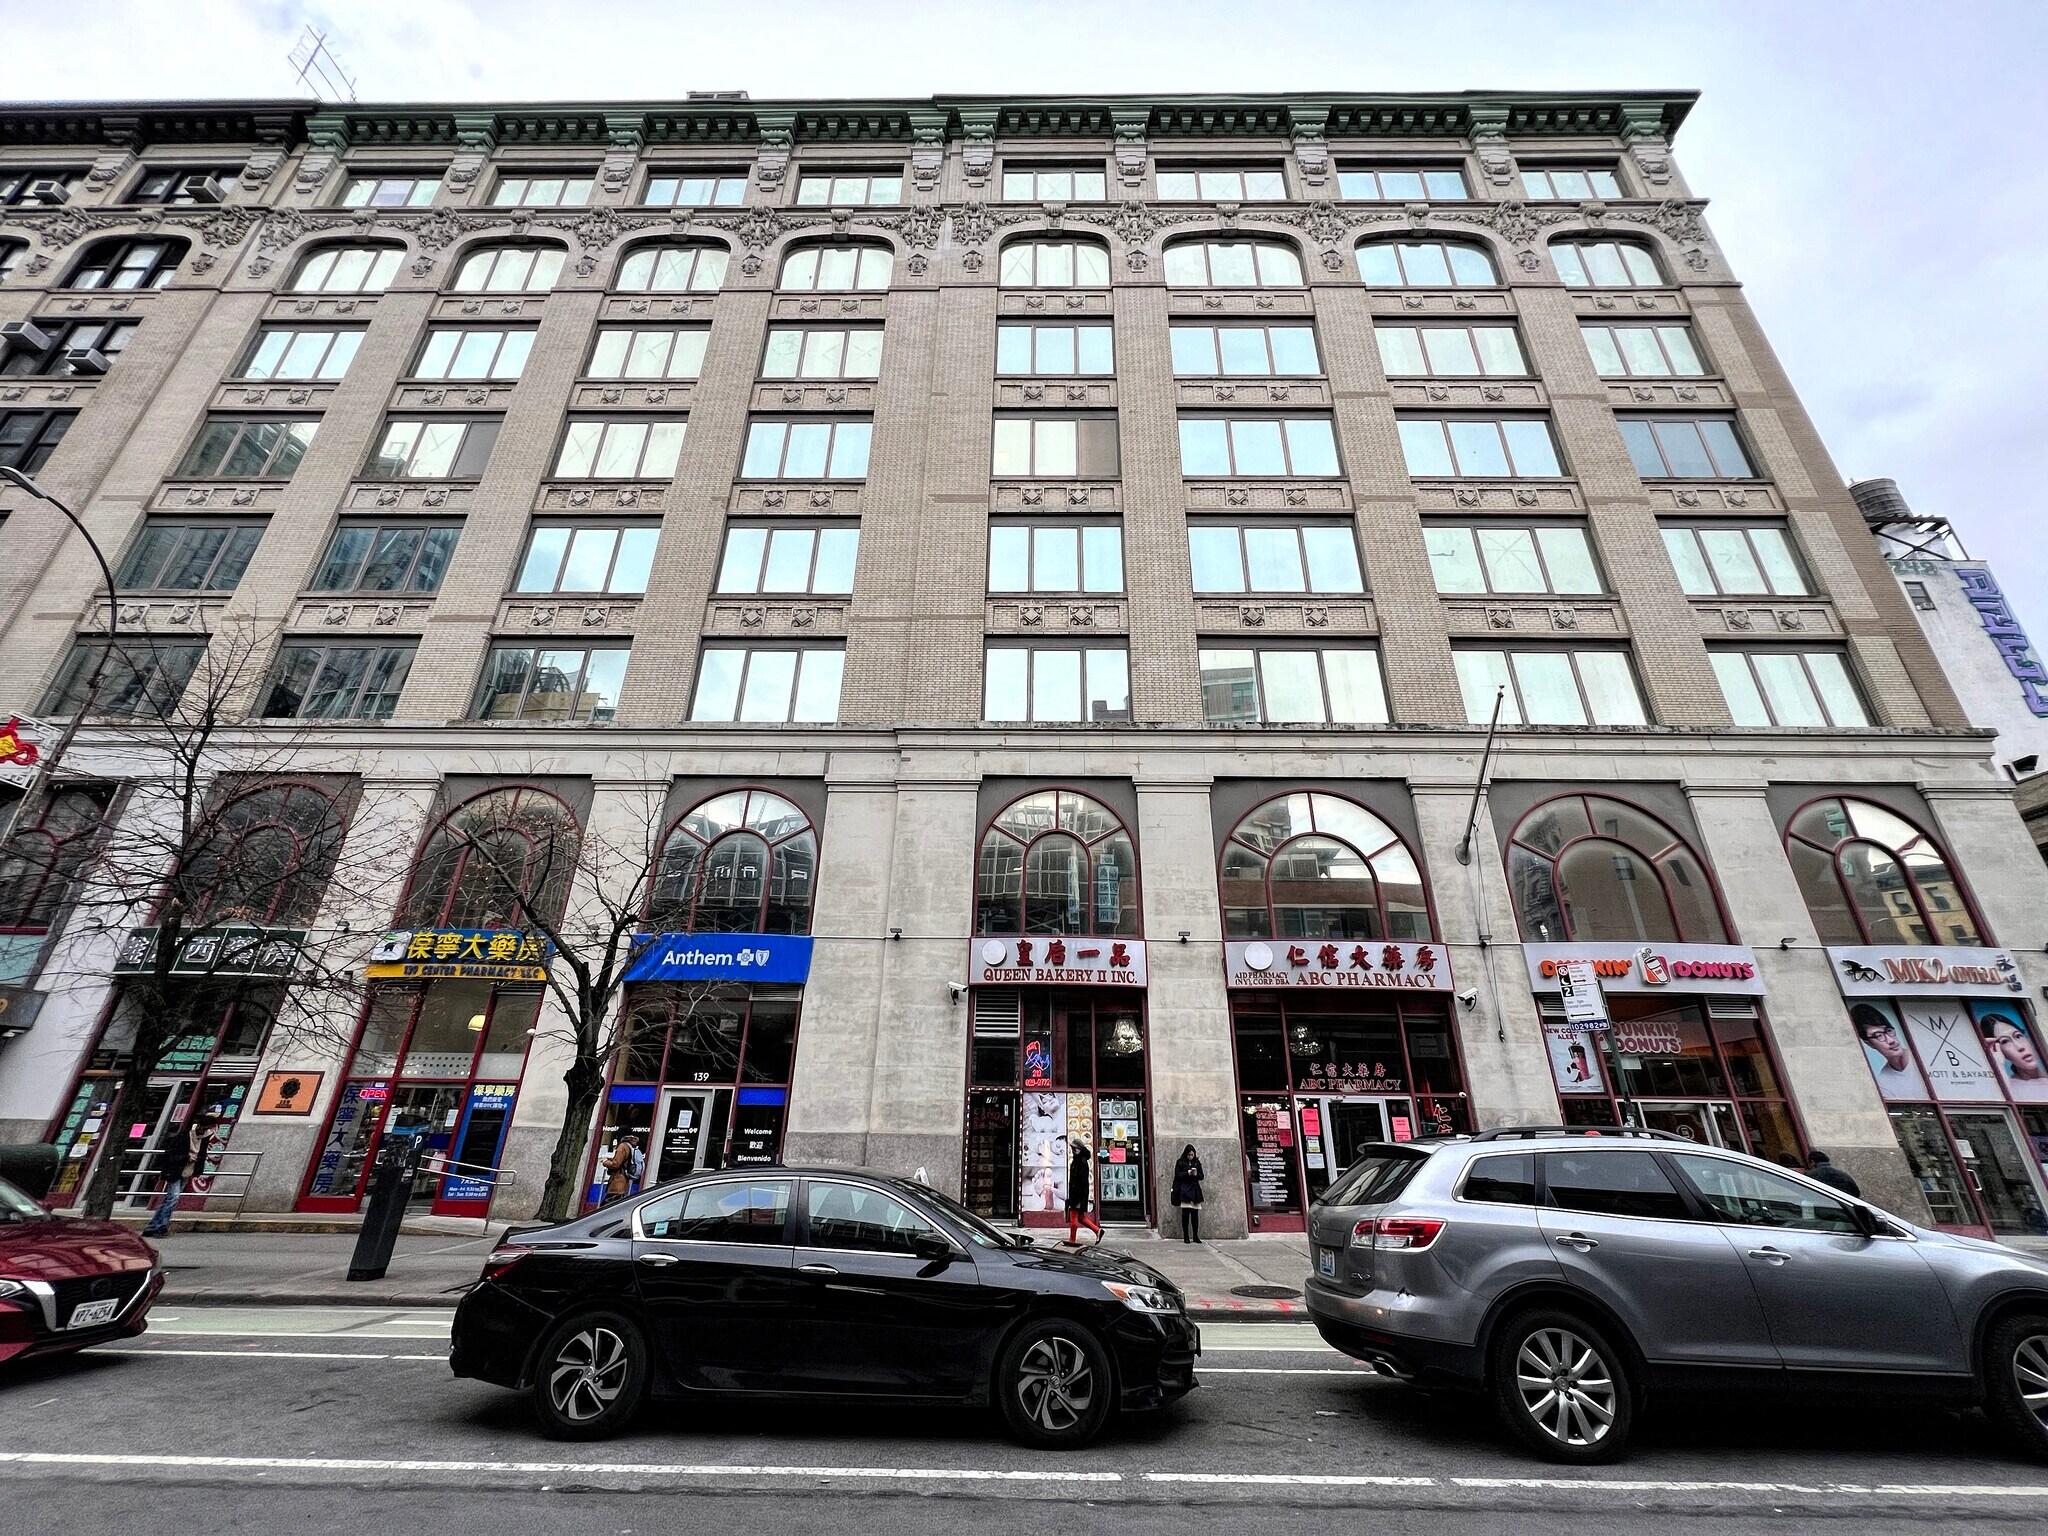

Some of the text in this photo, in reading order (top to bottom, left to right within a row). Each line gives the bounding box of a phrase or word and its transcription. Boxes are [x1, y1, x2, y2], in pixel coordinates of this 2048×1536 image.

[118, 935, 297, 967] 維西藥房
[662, 949, 733, 965] Anthem
[1016, 939, 1130, 967] 皇后一品
[1287, 944, 1438, 971] 仁信大藥房
[422, 965, 456, 976] CENTER
[460, 966, 517, 977] PHARMACY
[983, 968, 1138, 984] QUEEN BAKERY II INC.
[1235, 971, 1289, 979] AID PHARMACY
[1674, 960, 1754, 979] DONUTS
[1883, 958, 1949, 984] MK2
[1296, 972, 1436, 988] ABC PHARMACY
[1563, 987, 1572, 997] 2
[1928, 1016, 1949, 1031] M
[1615, 1037, 1681, 1053] DONUTS
[1946, 1051, 1960, 1066] B
[693, 1072, 710, 1082] 139
[1952, 1070, 1959, 1078] &
[1300, 1079, 1402, 1090] ABC PHARMACY
[359, 1088, 388, 1099] OPEN
[414, 1135, 422, 1148] P
[737, 1154, 772, 1162] Bienvenido
